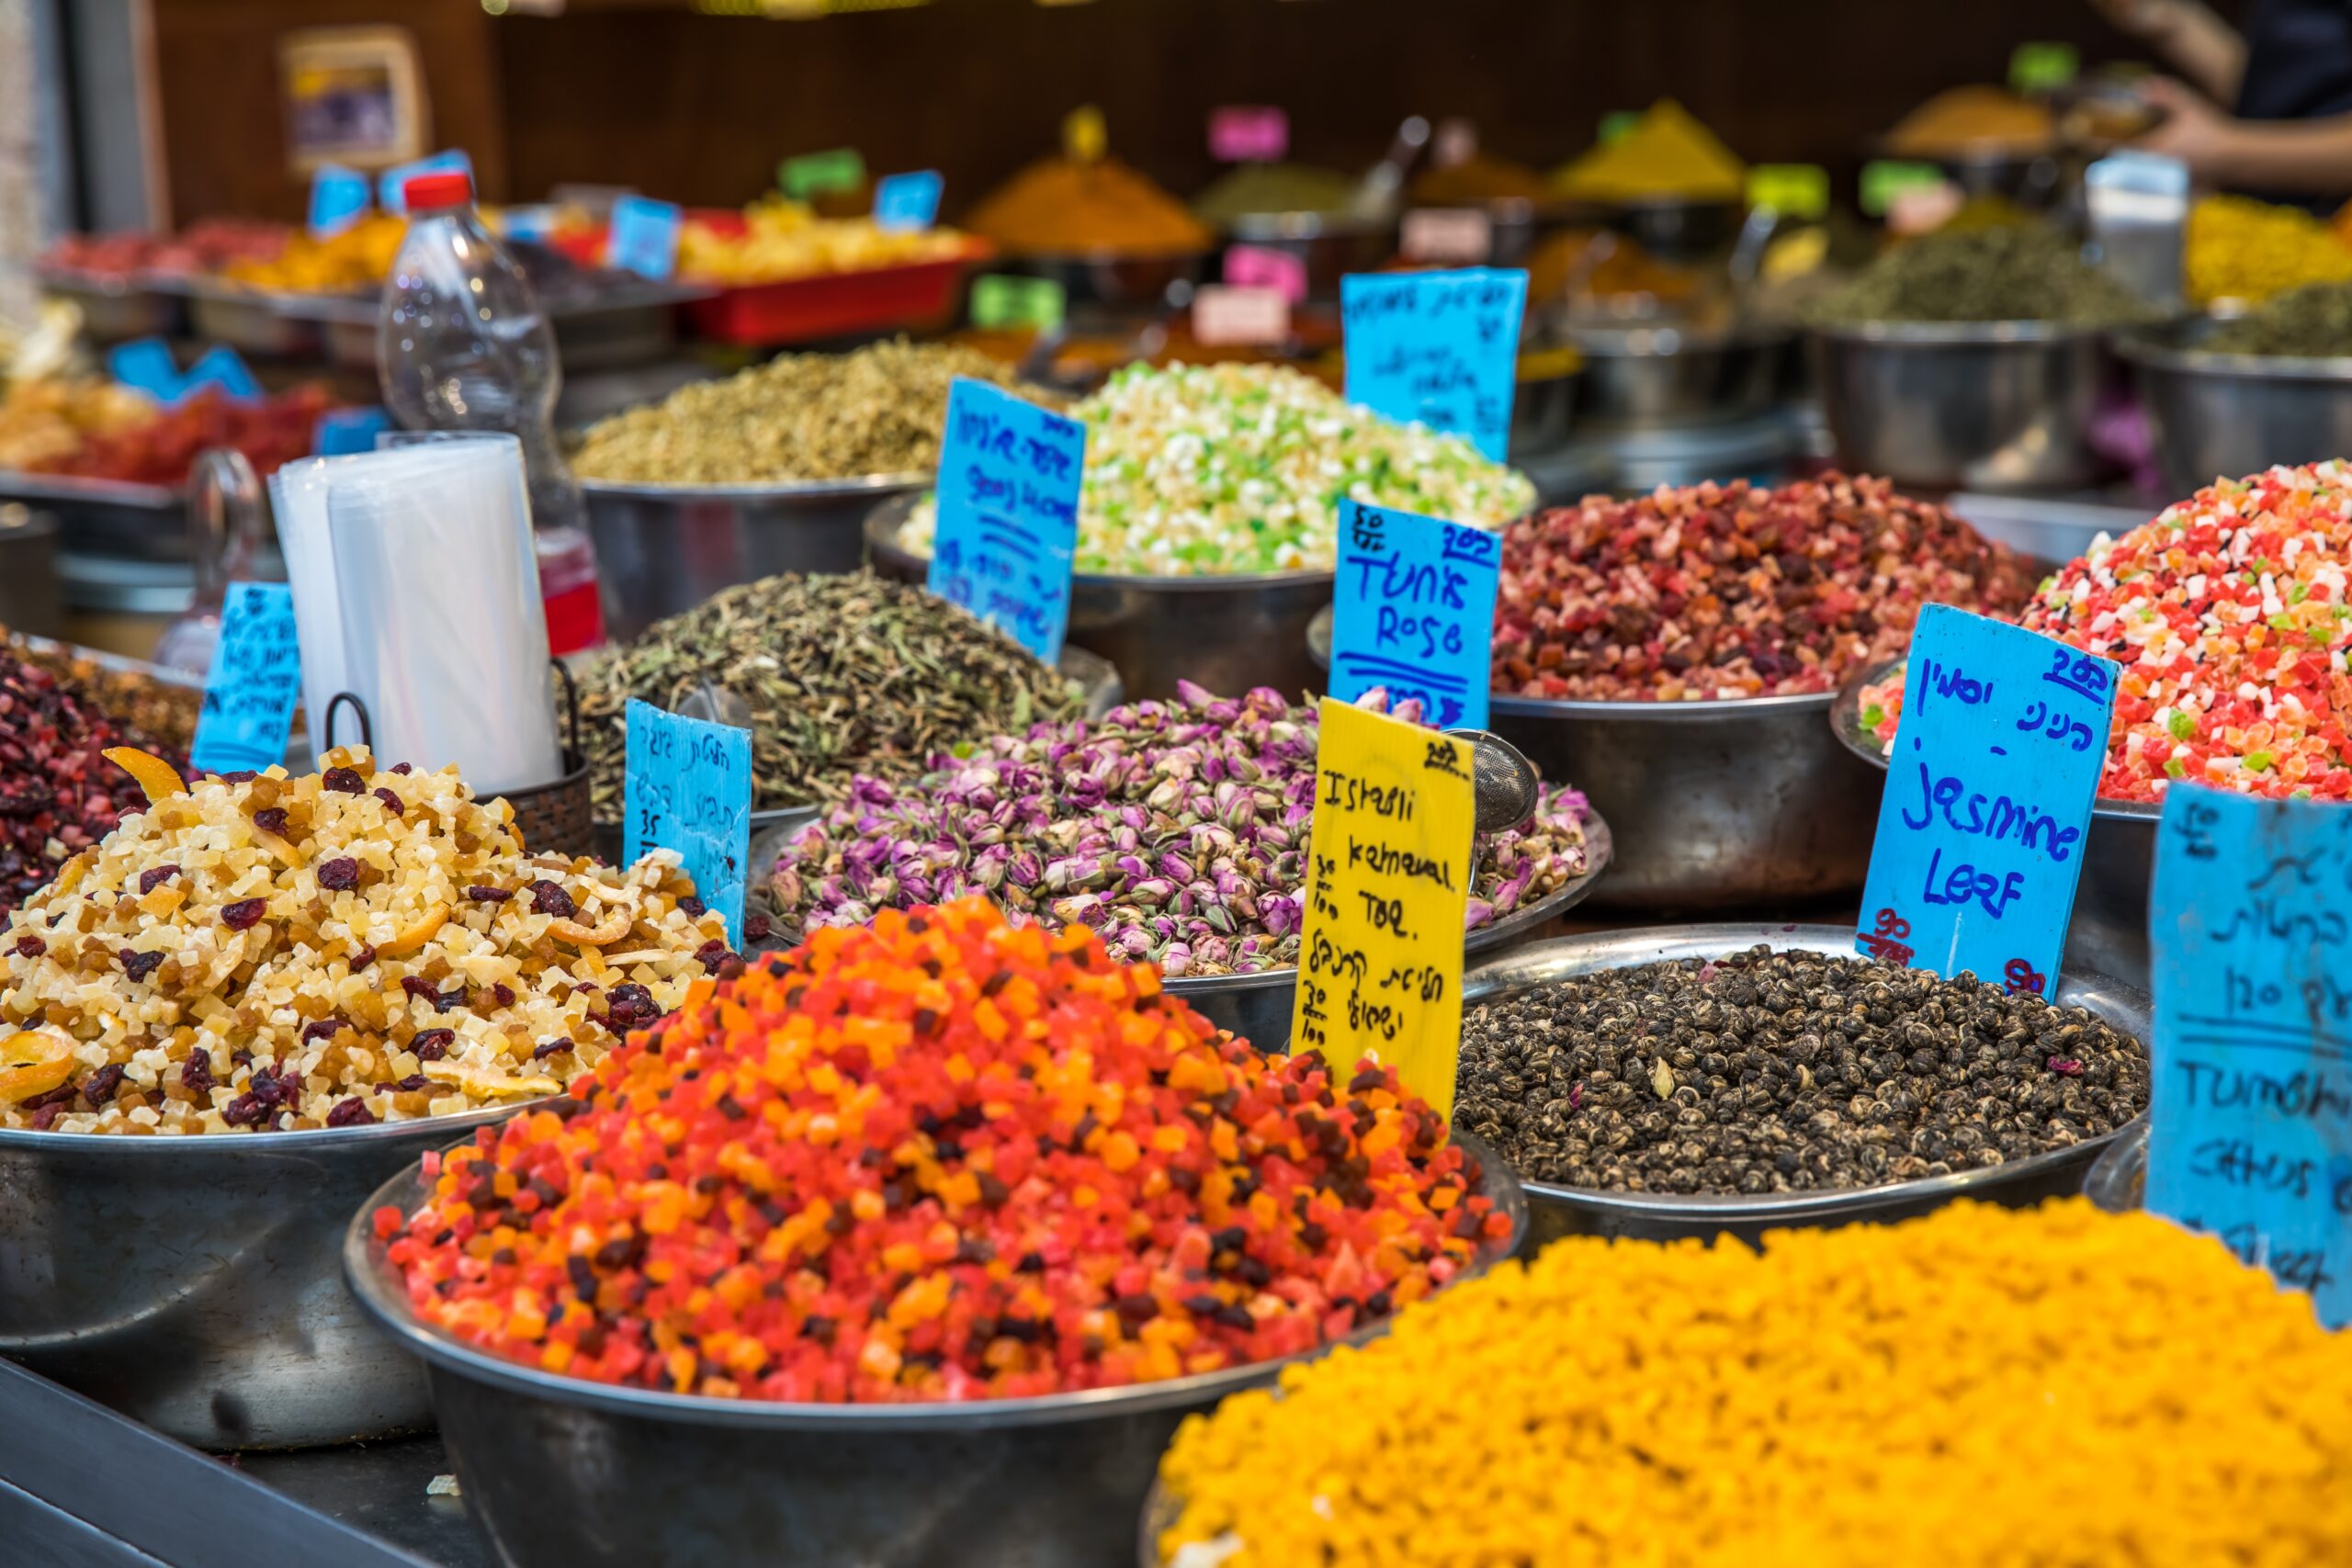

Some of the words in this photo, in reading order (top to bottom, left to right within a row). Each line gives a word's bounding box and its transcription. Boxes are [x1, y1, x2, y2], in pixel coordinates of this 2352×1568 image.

[1375, 605, 1464, 658] Rose
[640, 808, 661, 837] 35
[1379, 965, 1444, 1003] חליטת
